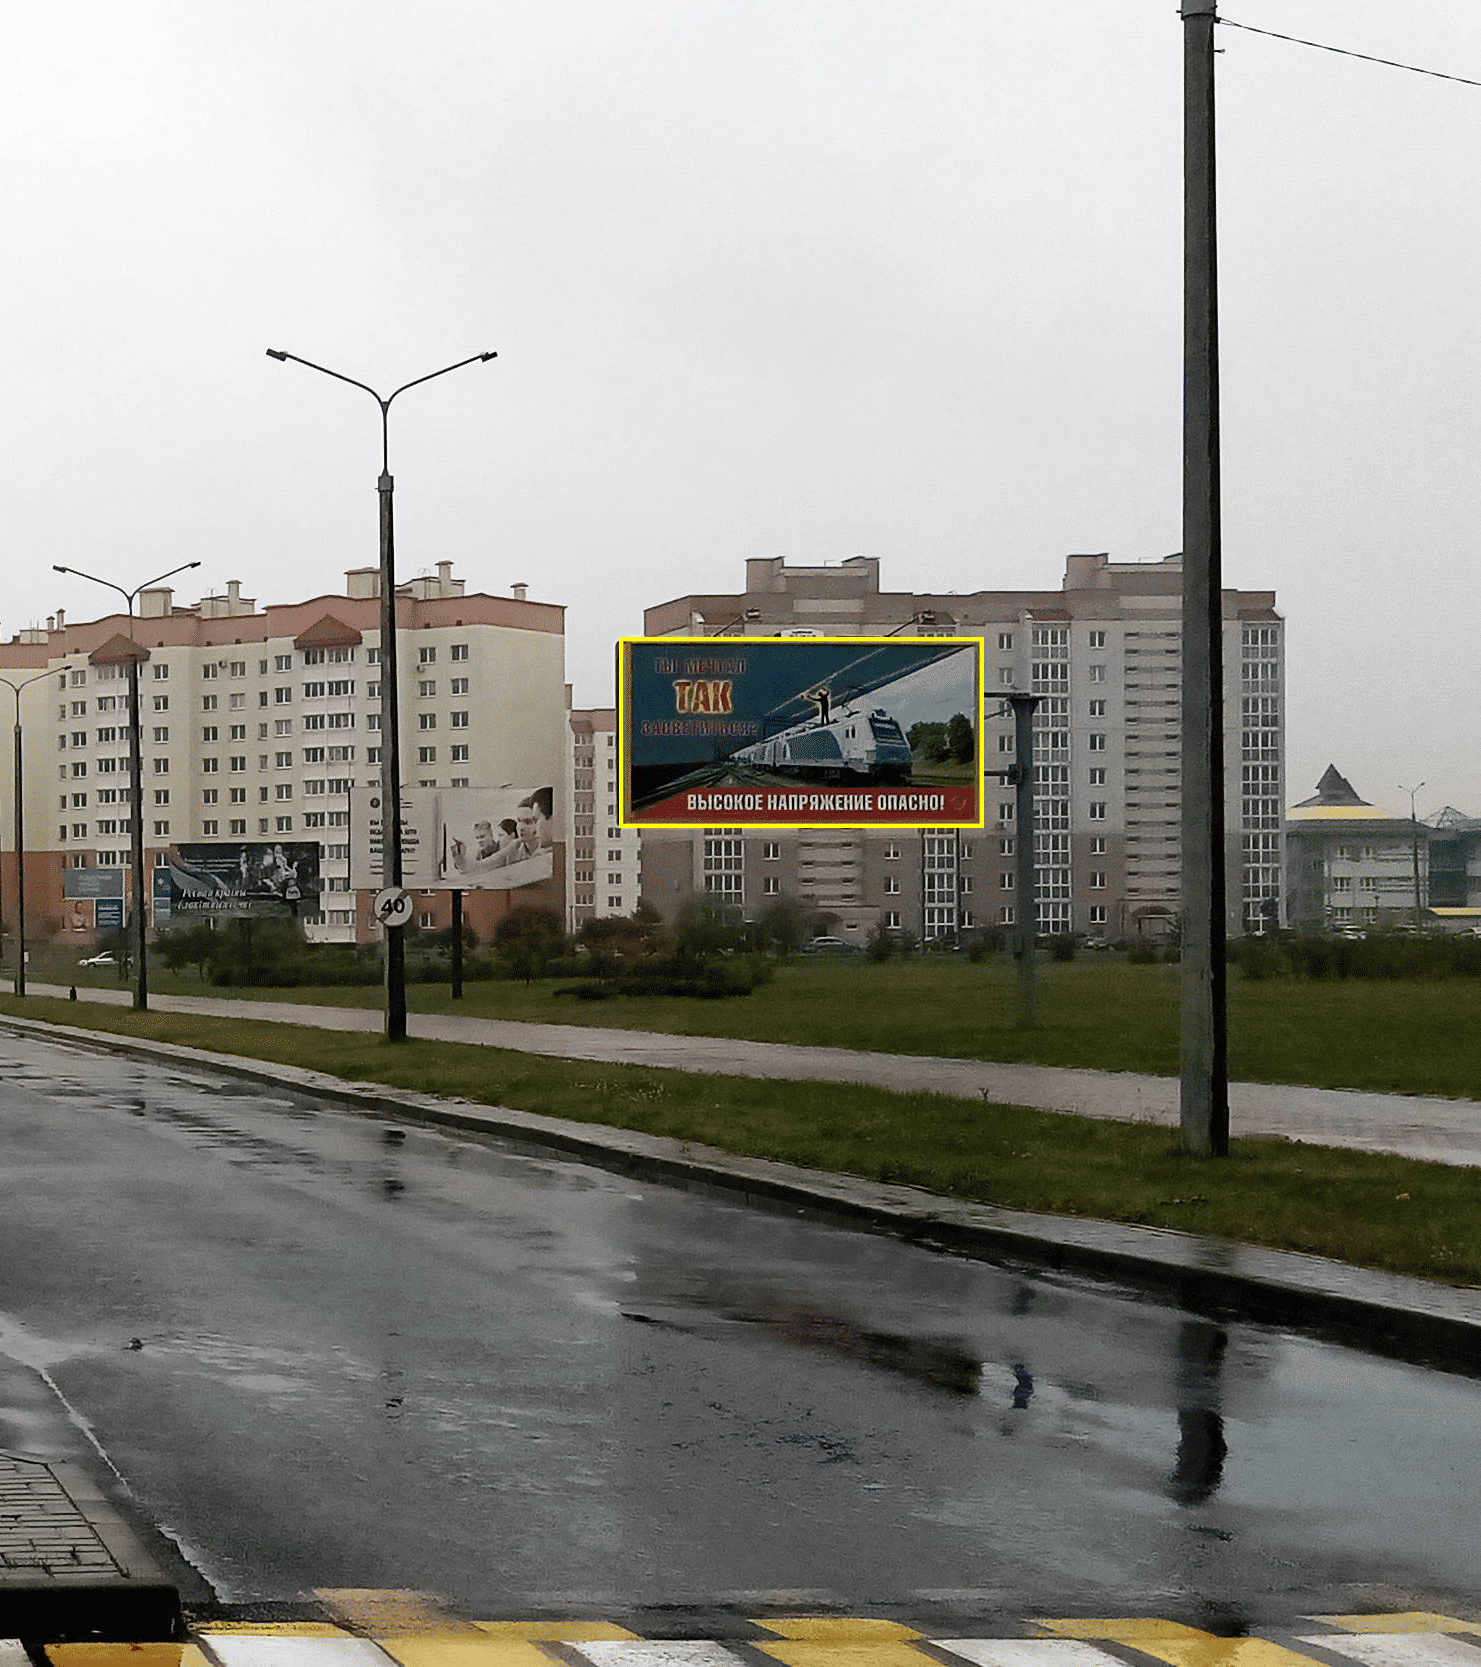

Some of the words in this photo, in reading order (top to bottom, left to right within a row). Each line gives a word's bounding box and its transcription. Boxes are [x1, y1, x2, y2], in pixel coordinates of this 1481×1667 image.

[654, 657, 678, 674] ТЫ
[684, 657, 747, 674] МЕЧТАЛ
[672, 678, 734, 715] ТАК
[687, 794, 764, 811] ВЫСОКОЕ
[768, 793, 873, 811] НАПРЯЖЕНИЕ
[877, 793, 945, 811] ОПАСНО!
[381, 897, 405, 915] 40
